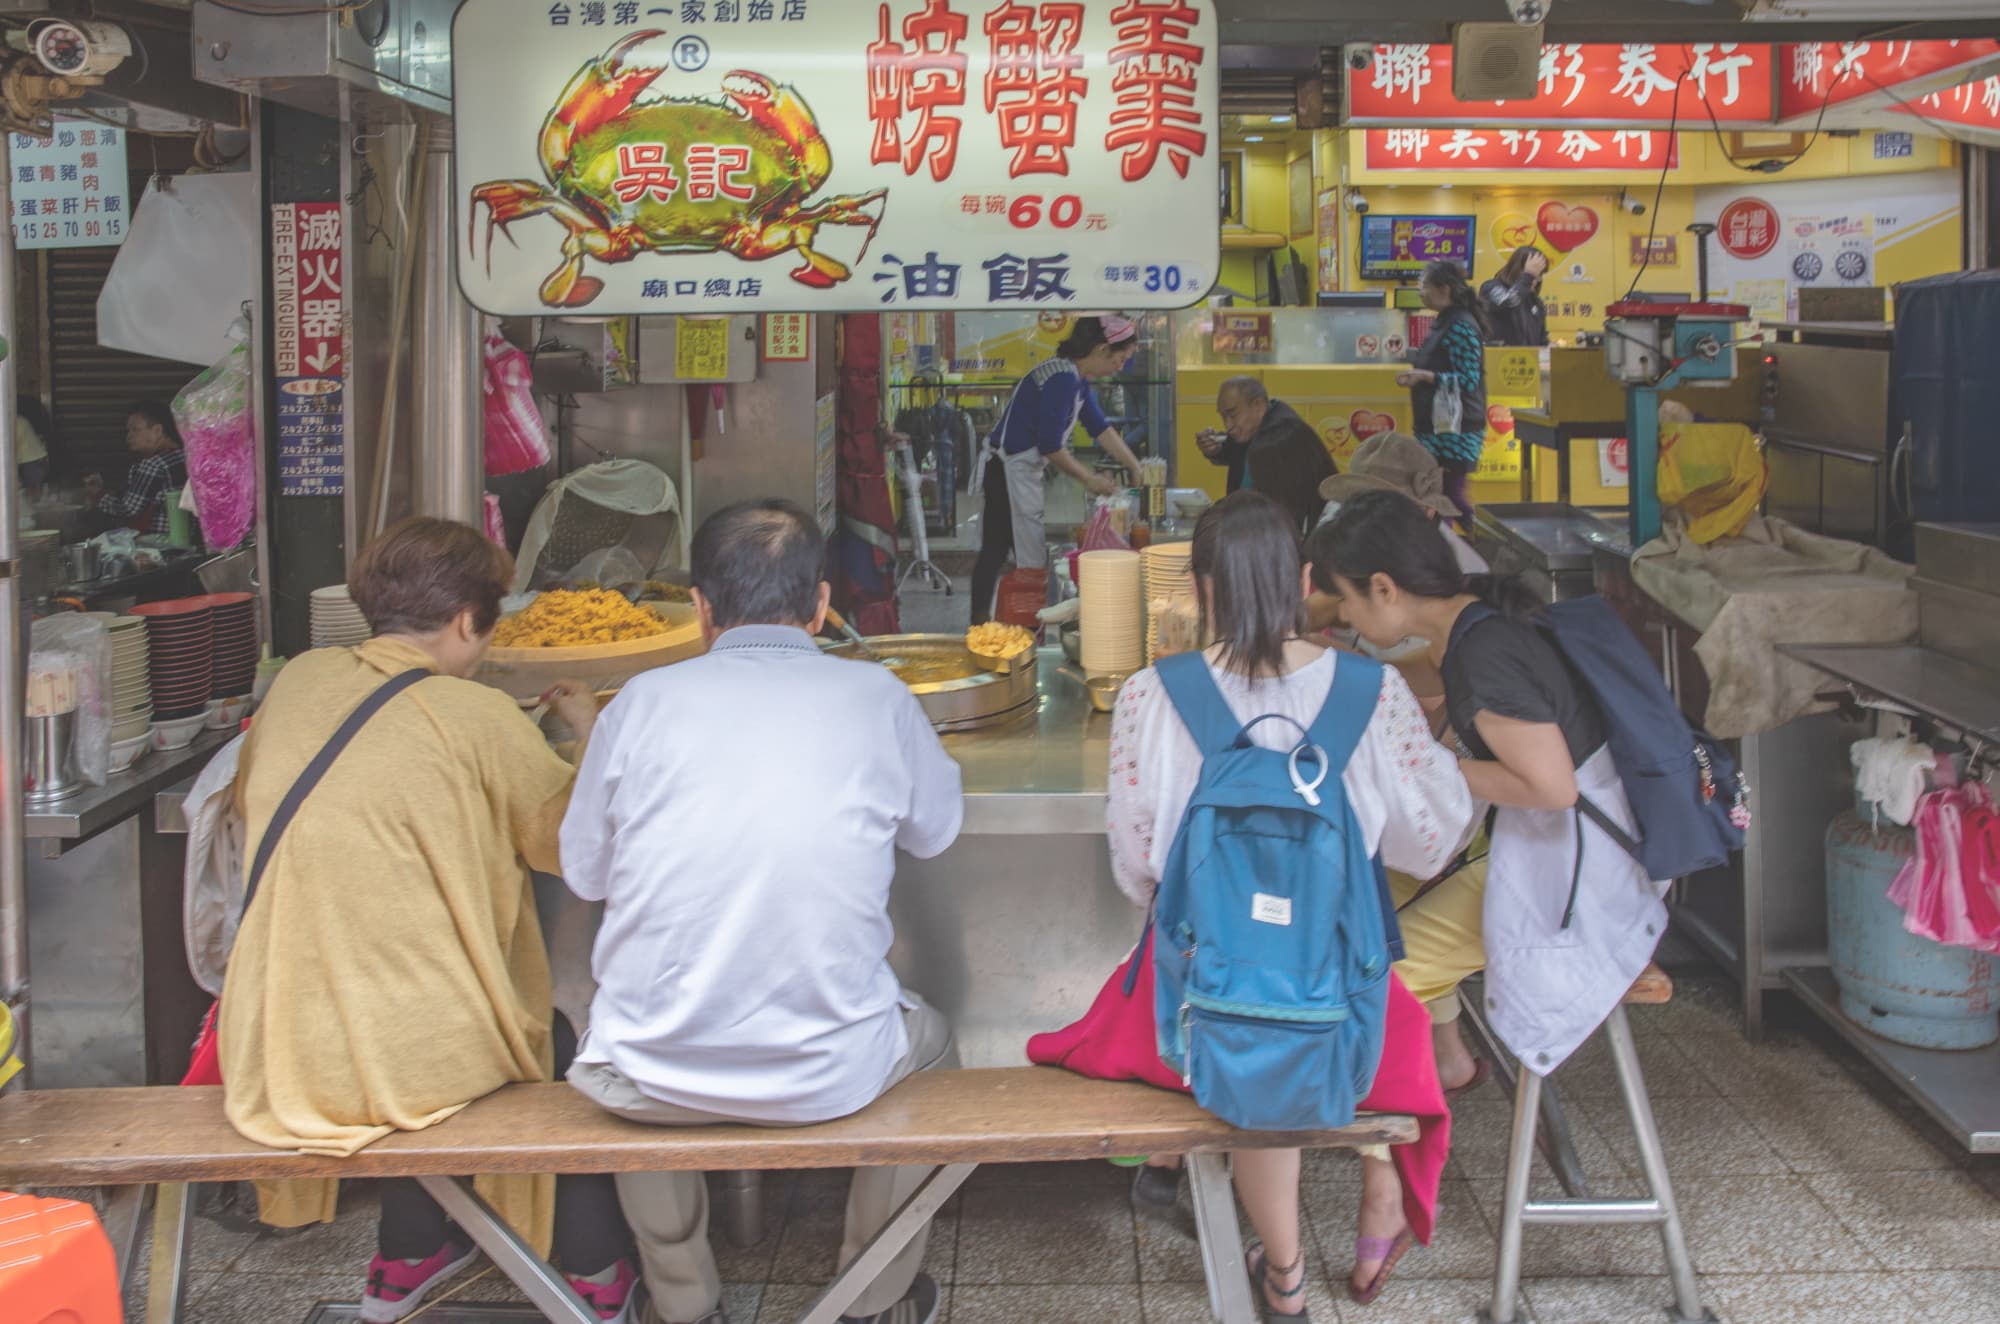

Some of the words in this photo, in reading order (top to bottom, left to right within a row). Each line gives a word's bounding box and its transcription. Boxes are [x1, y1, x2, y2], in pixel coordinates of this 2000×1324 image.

[548, 0, 807, 26] 台灣第一家創始店
[866, 0, 1207, 182] 螃蟹羹
[1371, 43, 1753, 107] 聯彩券行
[614, 145, 754, 203] 吳記
[275, 208, 295, 373] FIRE-EXTINGUISHER
[299, 209, 342, 338] 滅火器
[641, 278, 763, 298] 廟口總店
[872, 251, 1077, 303] 油飯
